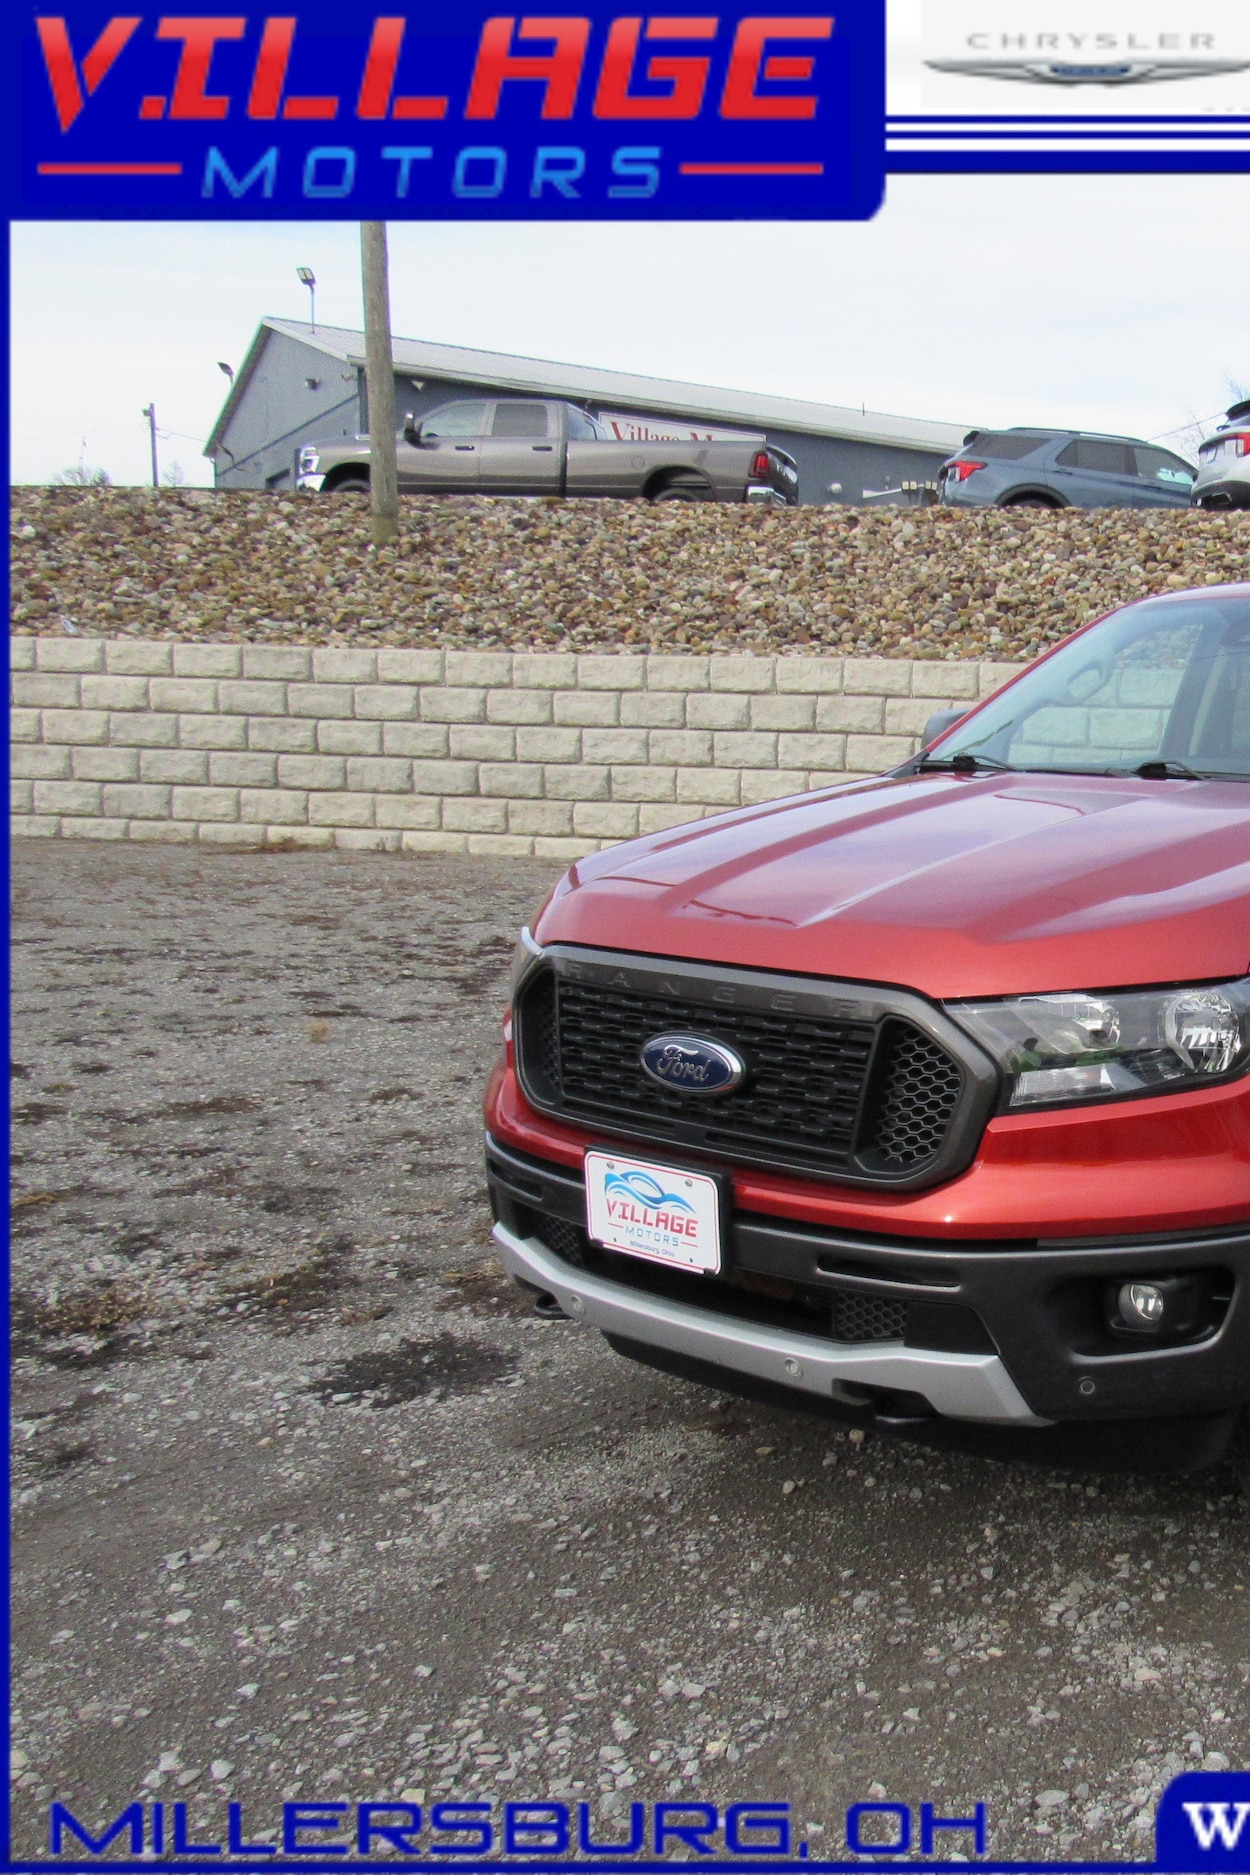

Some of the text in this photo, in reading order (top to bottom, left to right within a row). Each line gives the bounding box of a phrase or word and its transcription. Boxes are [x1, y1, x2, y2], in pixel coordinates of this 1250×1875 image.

[656, 1044, 712, 1081] Ford
[606, 1198, 698, 1237] VILLAGE
[625, 1225, 680, 1247] MOTORS
